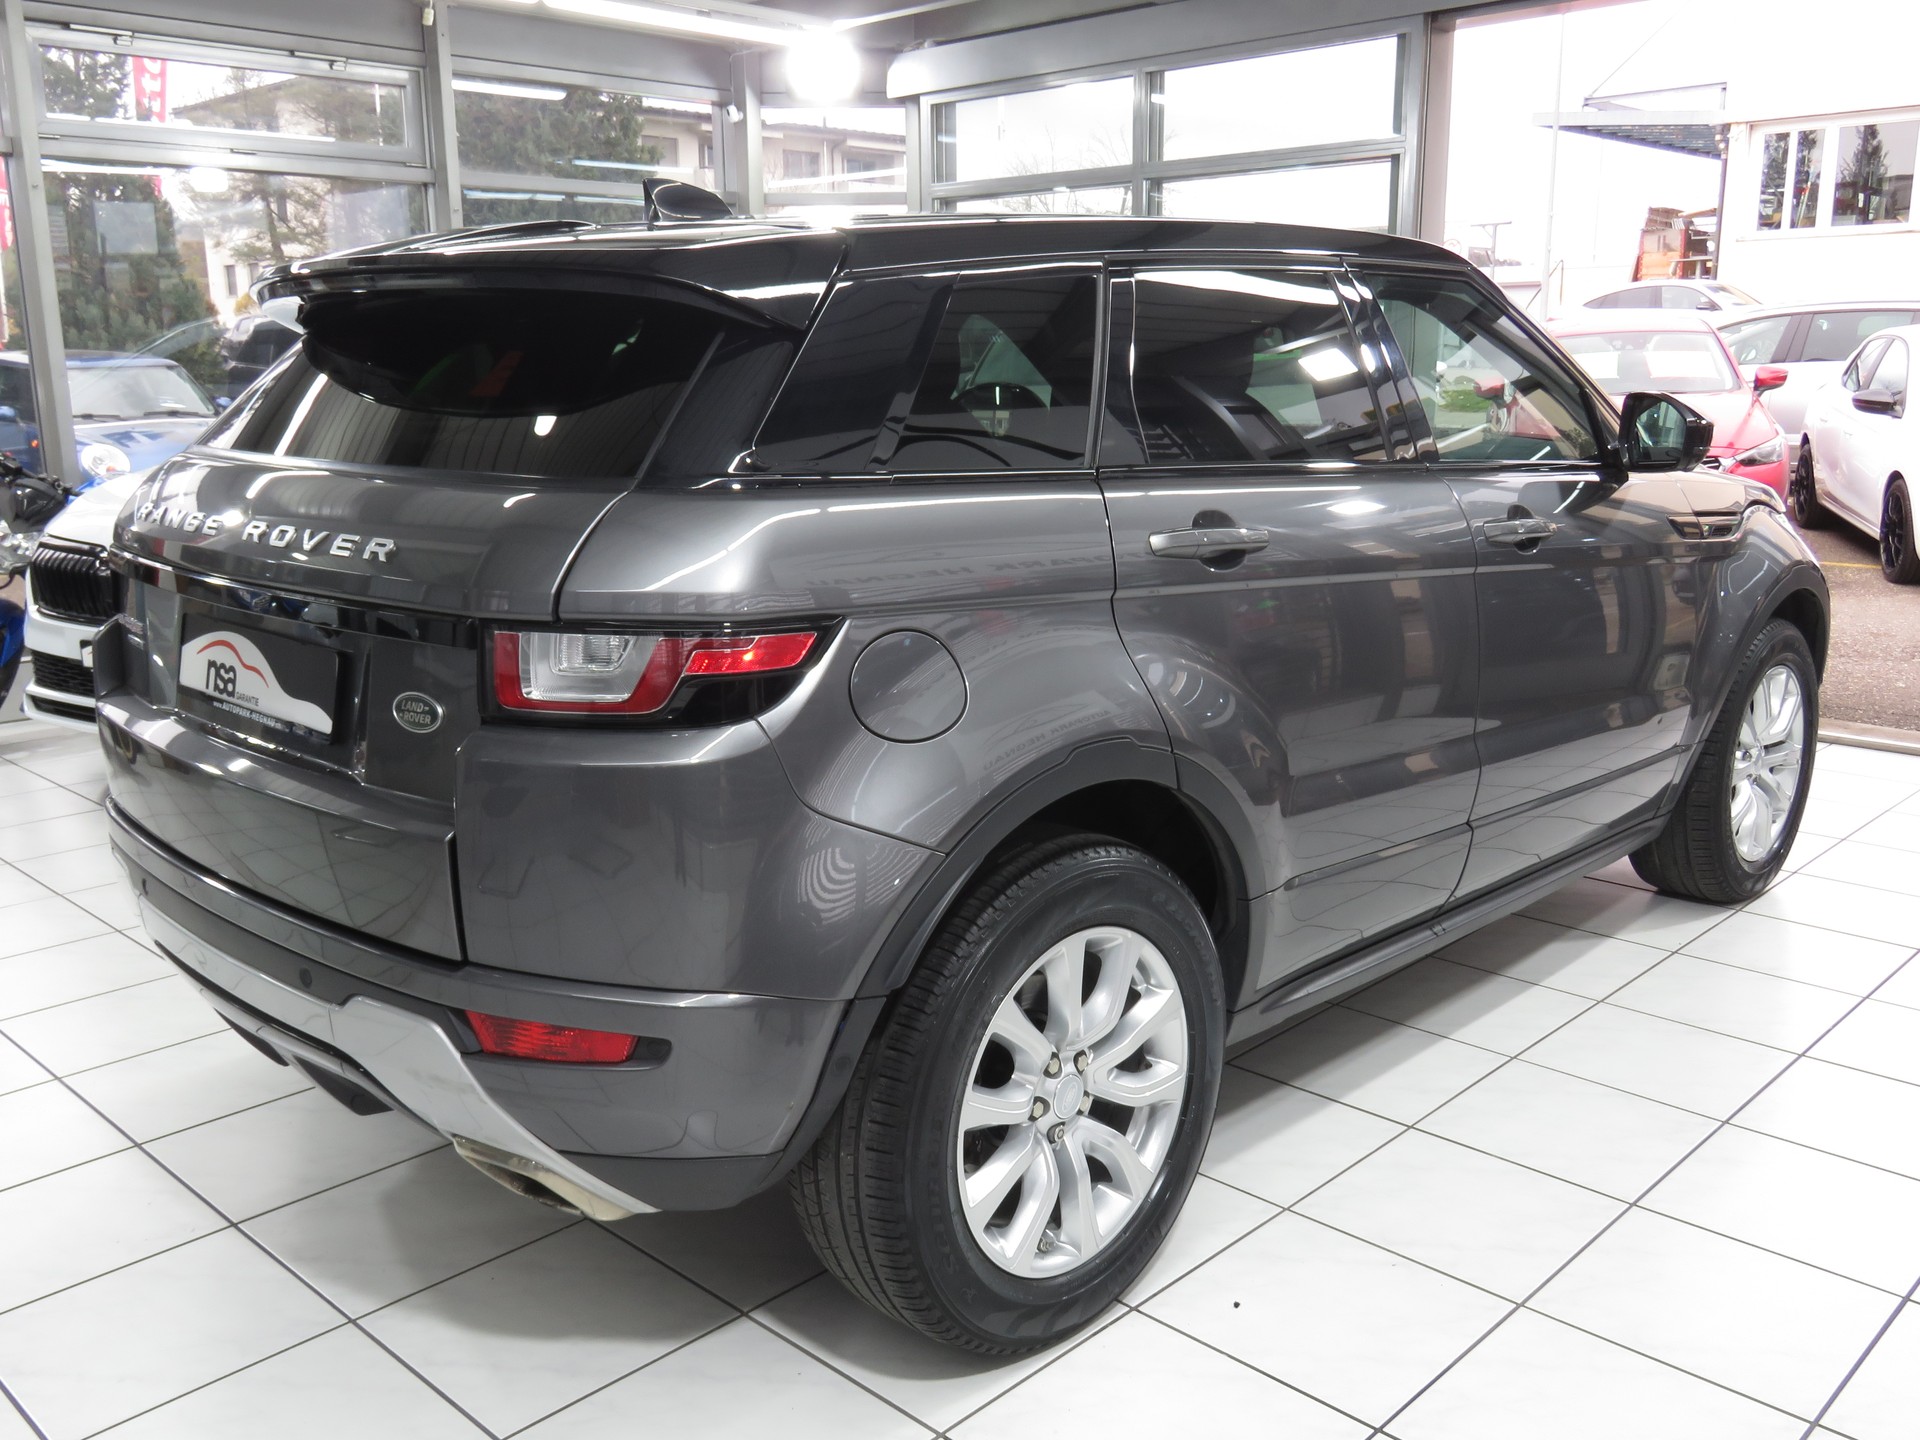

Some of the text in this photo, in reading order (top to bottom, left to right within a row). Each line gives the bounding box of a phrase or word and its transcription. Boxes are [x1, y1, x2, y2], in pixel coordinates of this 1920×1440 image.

[137, 502, 399, 563] RANGE ROVER
[206, 658, 237, 699] nsa
[236, 691, 260, 707] GARANTIE
